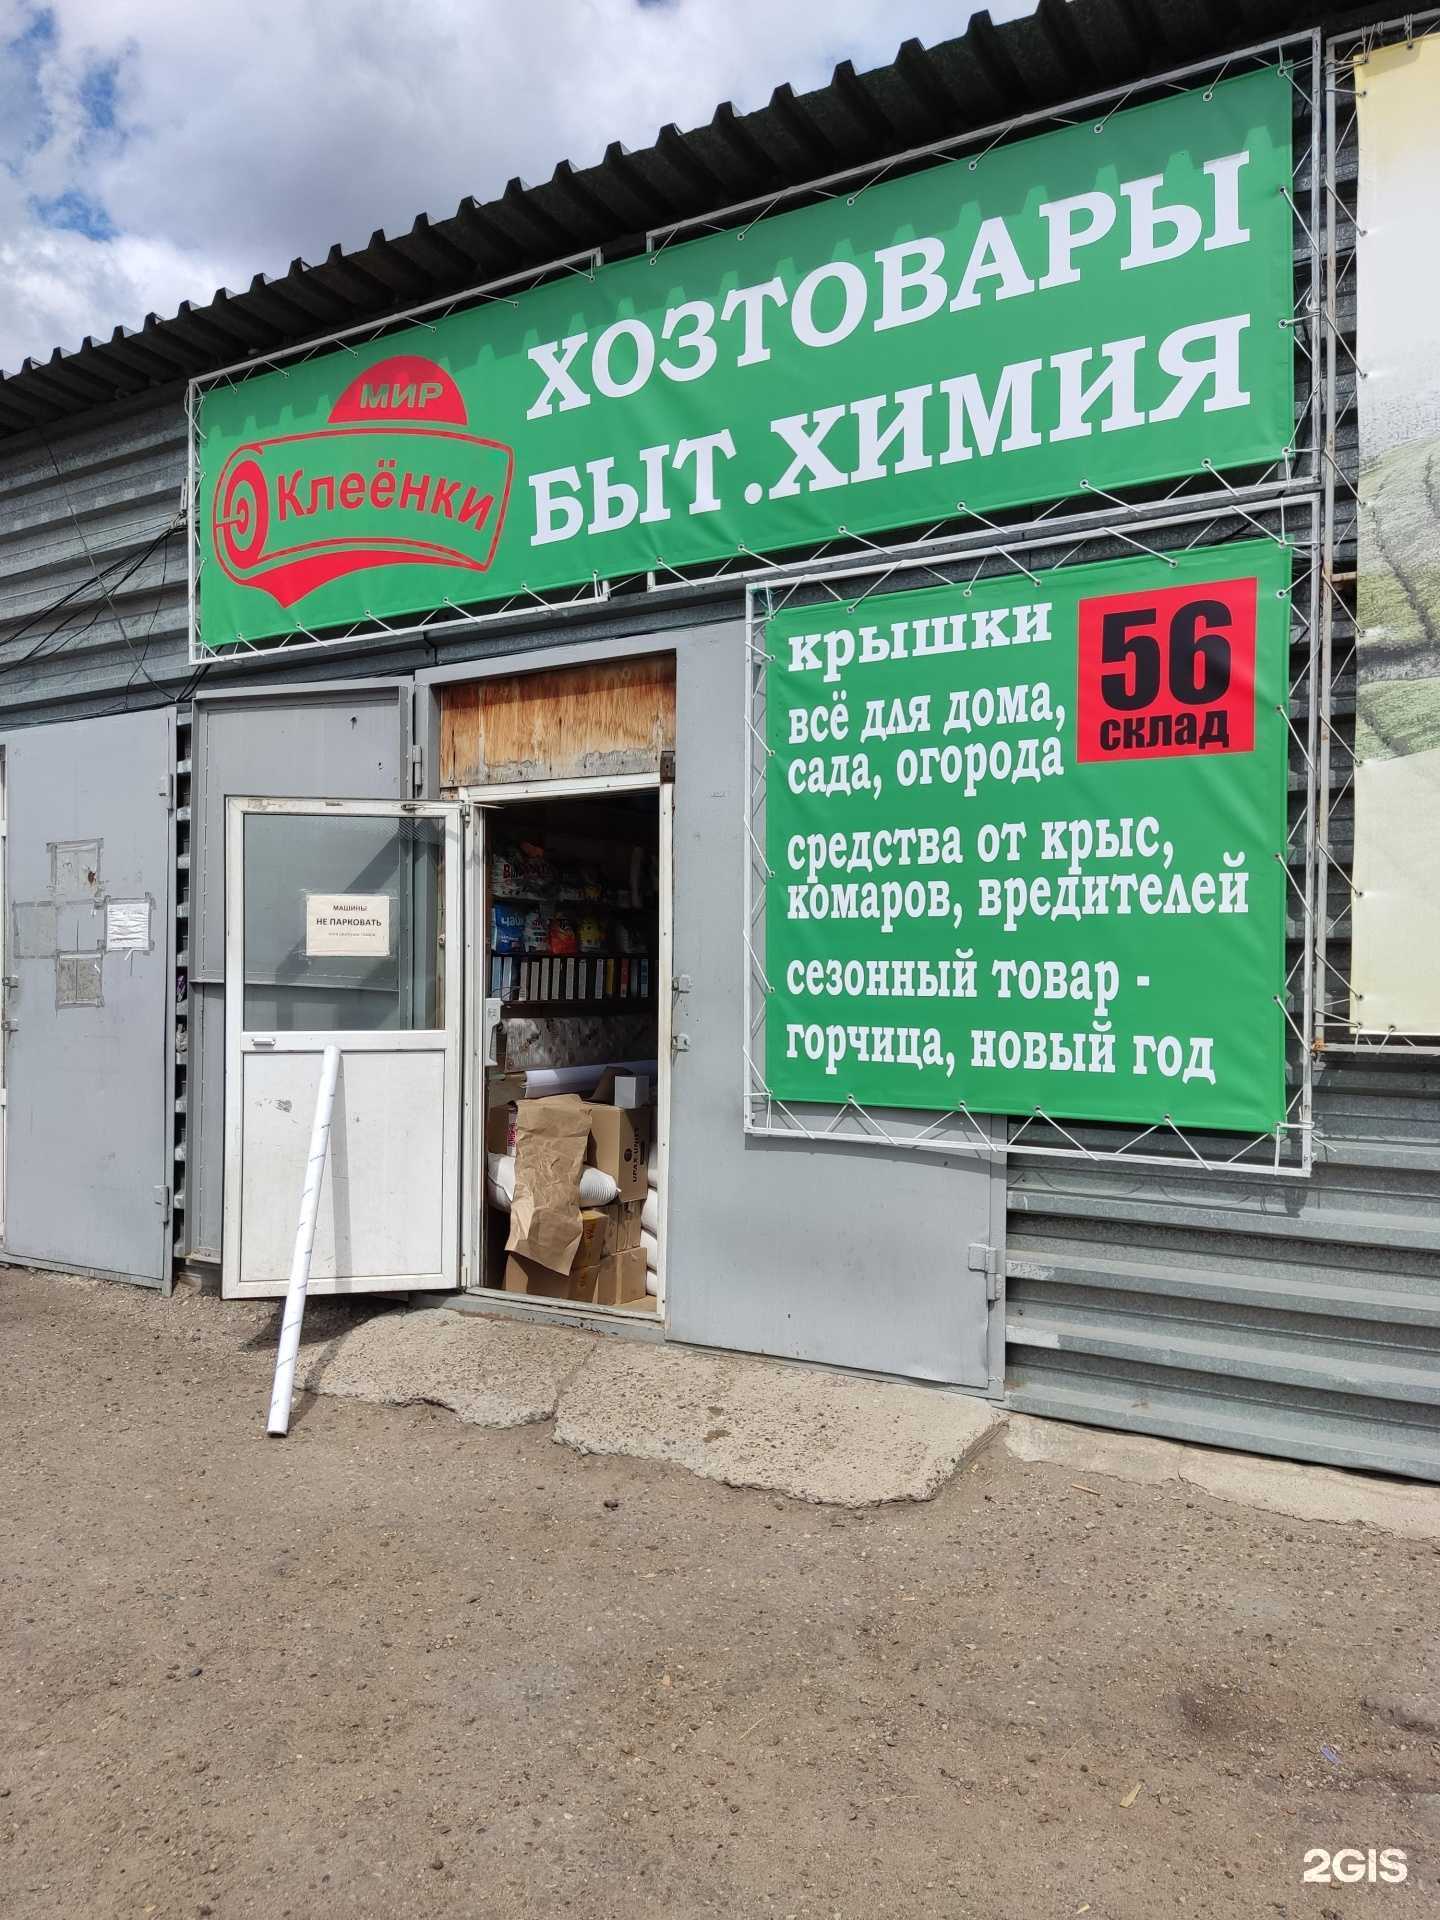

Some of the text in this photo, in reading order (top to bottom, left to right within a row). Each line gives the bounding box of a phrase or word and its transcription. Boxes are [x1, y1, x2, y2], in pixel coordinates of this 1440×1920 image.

[526, 149, 1252, 421] ХОЗТОВАРЫ
[360, 382, 443, 408] МИР
[277, 459, 495, 531] Клеёнки
[788, 602, 1053, 683] крышки
[1101, 600, 1231, 711] 56
[788, 682, 1066, 745] всё для дома,
[1099, 710, 1229, 750] склад
[787, 736, 1065, 801] сада, огорода
[787, 816, 1174, 884] средства от крыс,
[330, 918, 382, 926] ПАРКОВАТЬ
[787, 851, 1249, 933] комаров, вредителей
[786, 948, 978, 998] сезонный
[991, 959, 1120, 1017] товар
[786, 1020, 1217, 1086] горчица, новый год
